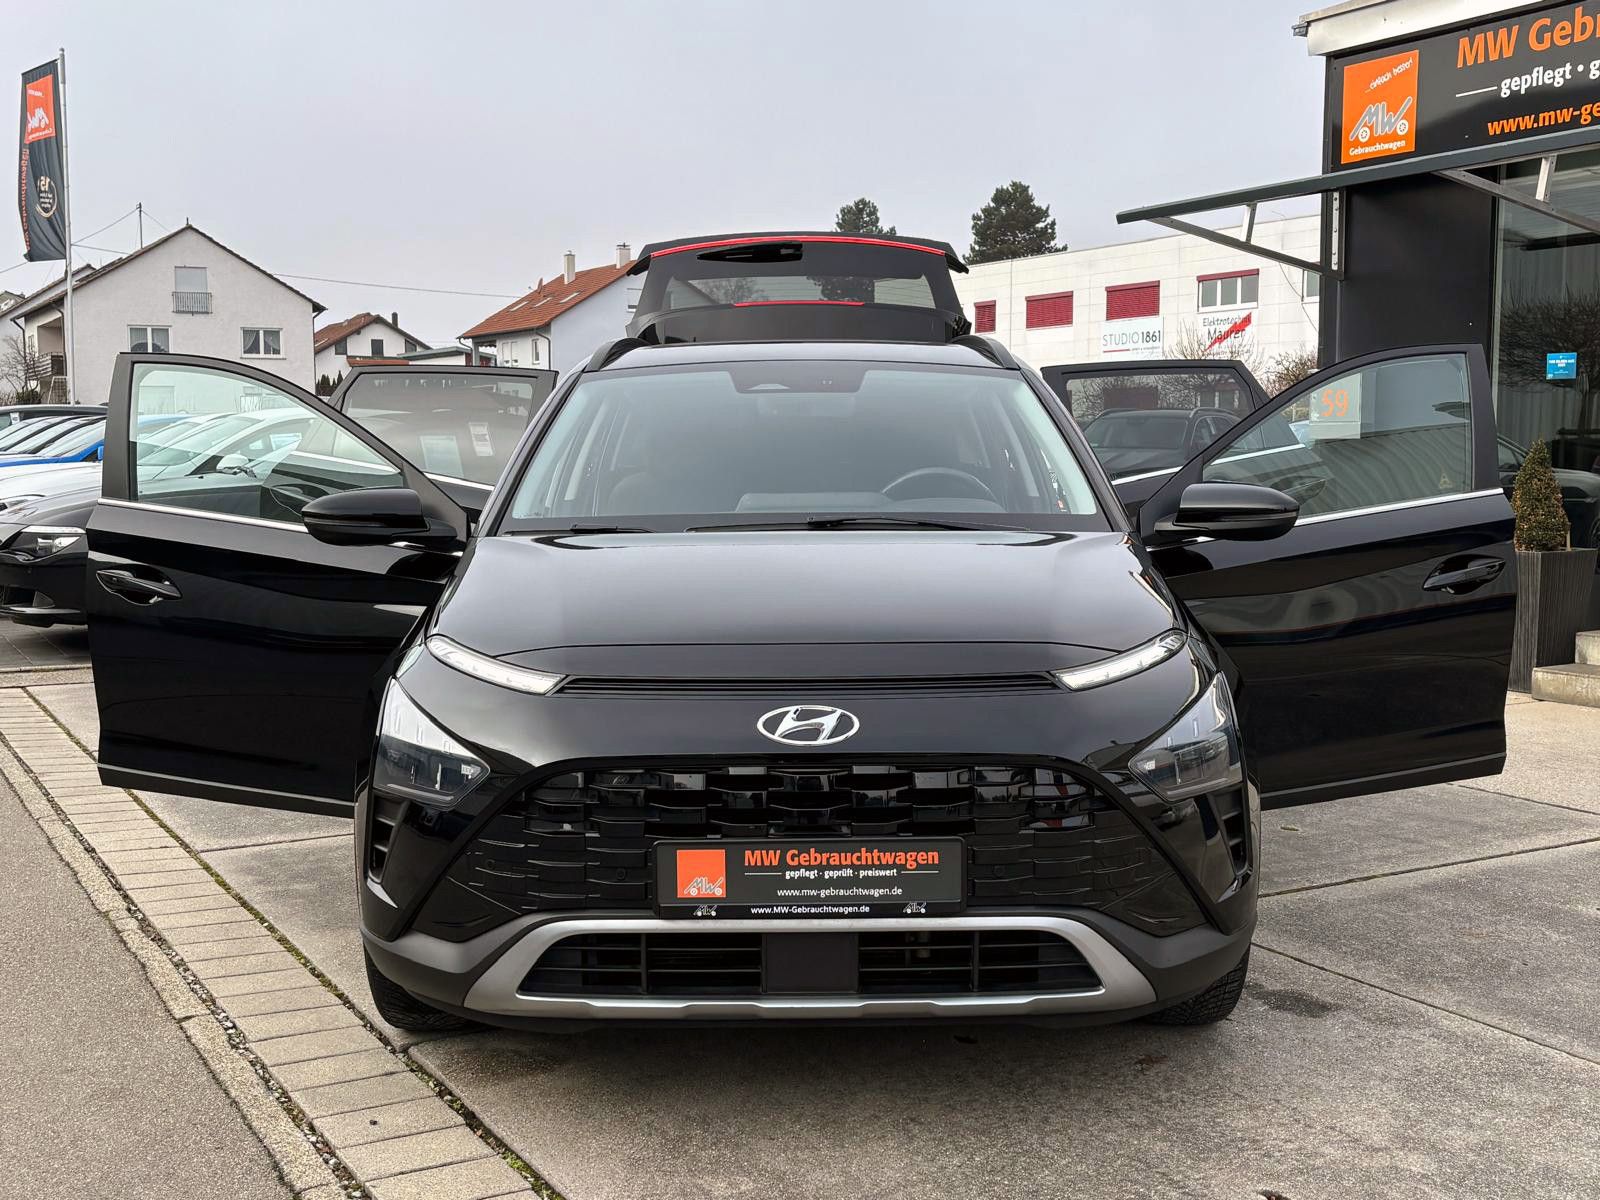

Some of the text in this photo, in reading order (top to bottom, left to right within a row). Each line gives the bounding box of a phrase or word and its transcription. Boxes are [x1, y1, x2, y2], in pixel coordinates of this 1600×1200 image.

[1456, 25, 1520, 69] MW
[1501, 61, 1572, 99] gepflegt
[1349, 96, 1414, 143] MW
[1349, 139, 1406, 156] Gebrauchtwagen
[744, 847, 940, 870] MW Gebrauchtwagen
[785, 867, 898, 879] gepflegt geprüft preiswert
[776, 885, 903, 898] www.mw-gebrauchtwagen.de
[750, 903, 870, 915] www.MW-Gebrauchtwagen.de
